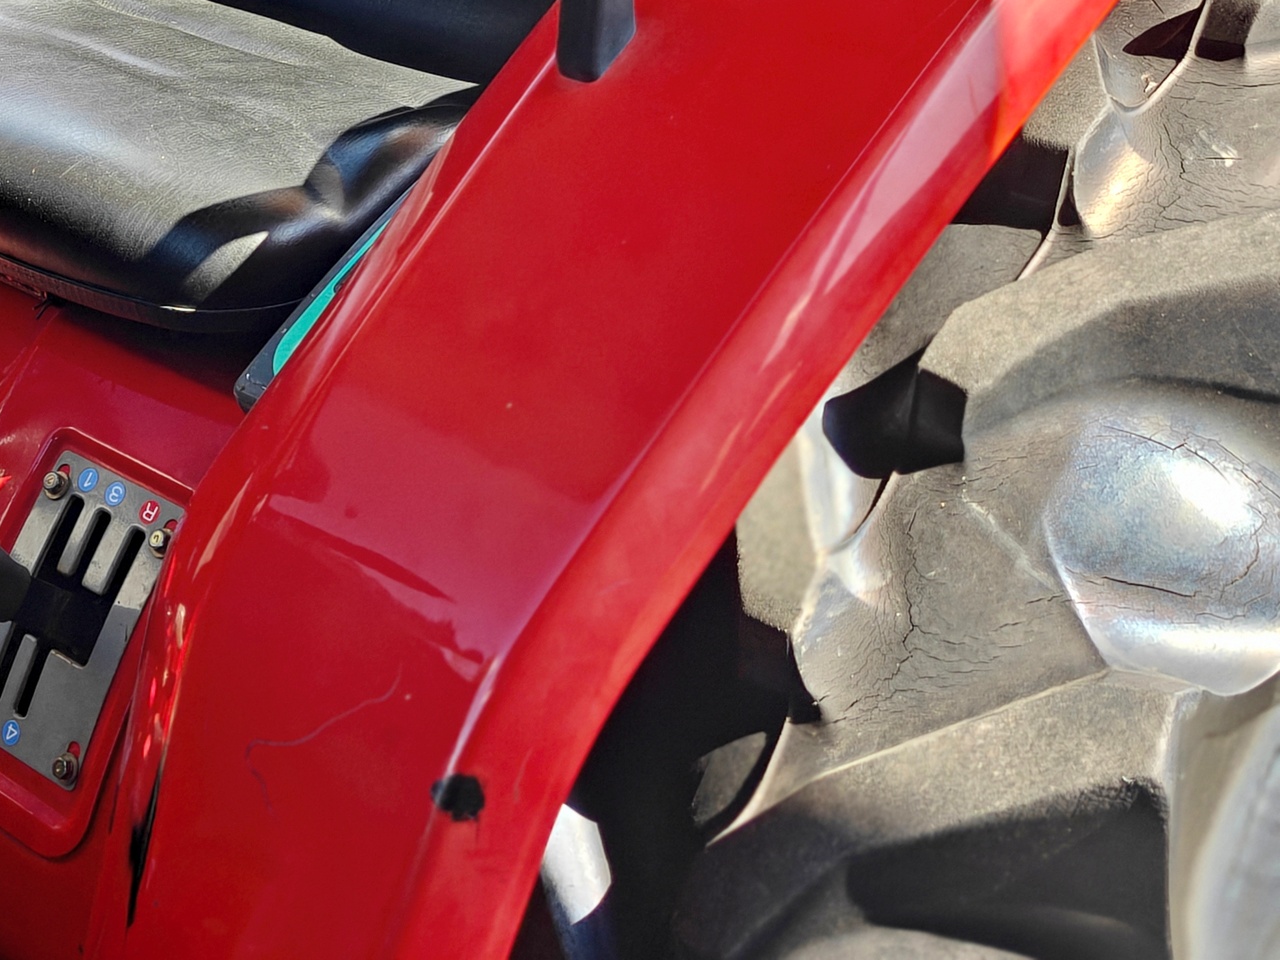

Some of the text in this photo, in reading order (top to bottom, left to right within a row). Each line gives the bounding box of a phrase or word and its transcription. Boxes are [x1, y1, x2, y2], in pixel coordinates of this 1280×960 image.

[83, 472, 93, 487] 1
[108, 486, 123, 503] 3
[142, 502, 159, 522] R
[6, 723, 18, 740] 4
